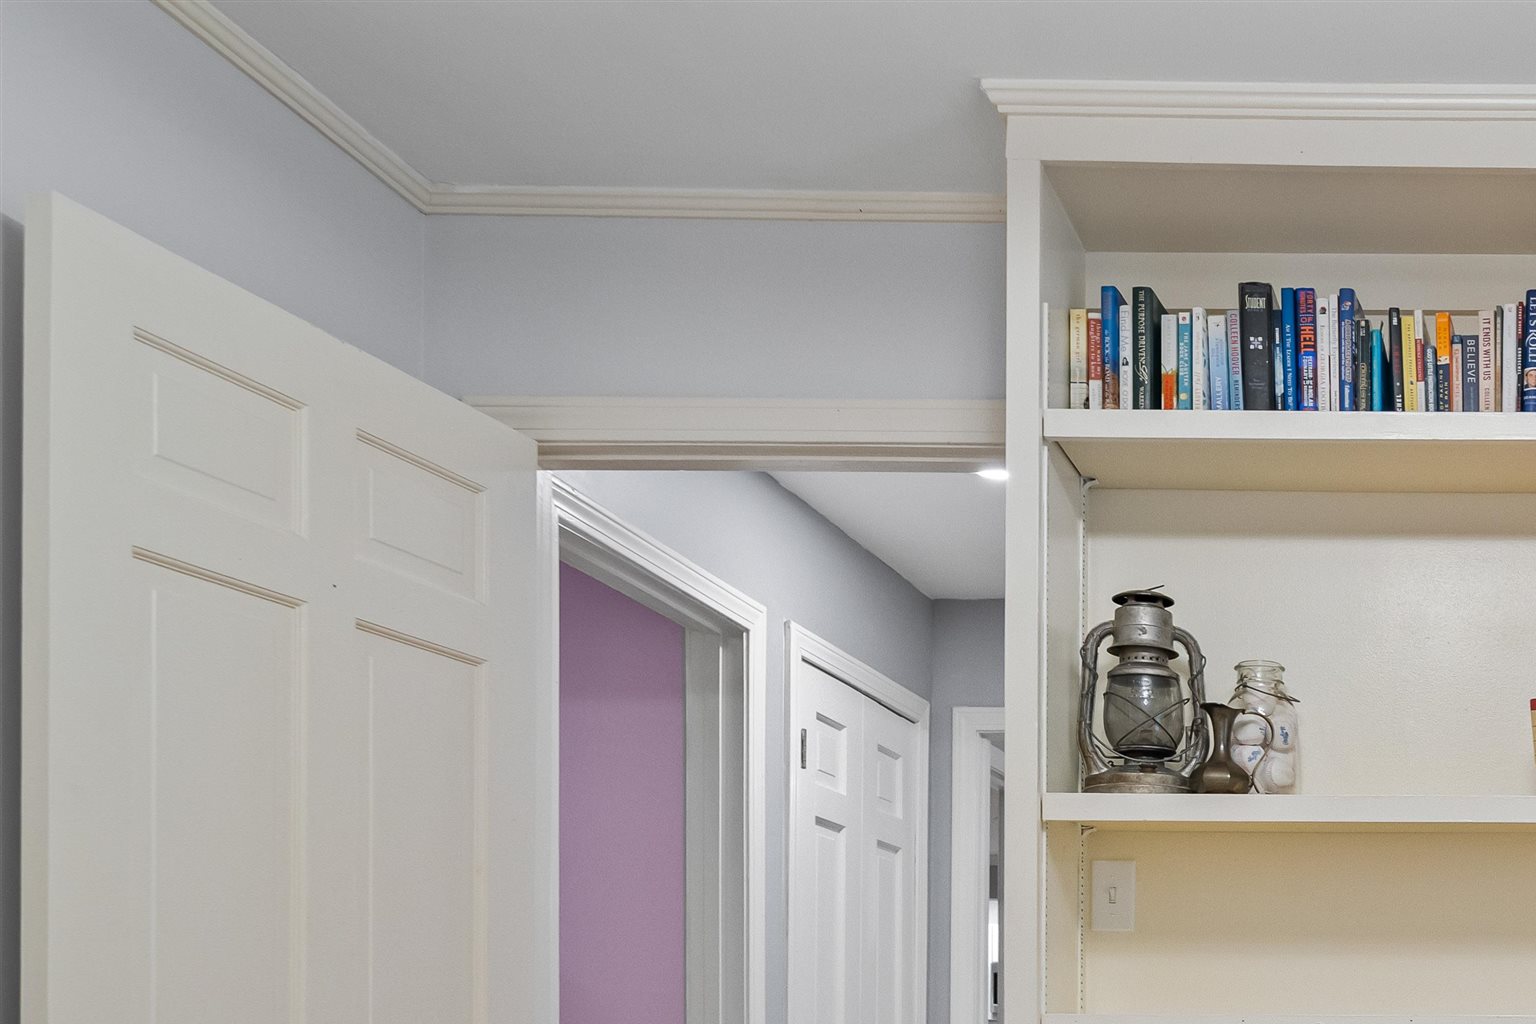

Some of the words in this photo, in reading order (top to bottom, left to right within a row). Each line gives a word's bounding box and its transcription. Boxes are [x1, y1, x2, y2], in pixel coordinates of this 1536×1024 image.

[1245, 294, 1266, 310] STUDENT
[1120, 310, 1129, 331] Find
[1138, 304, 1146, 333] PURPOSE
[1230, 313, 1239, 344] COLLEEN
[1121, 336, 1129, 352] Me
[1300, 326, 1315, 355] HELL
[1483, 327, 1491, 347] ENDS
[1232, 347, 1240, 375] HOOVER
[1467, 339, 1476, 383] BELIEVE
[1483, 348, 1491, 369] WITH
[1483, 370, 1491, 381] US
[1215, 376, 1223, 410] MALLERY
